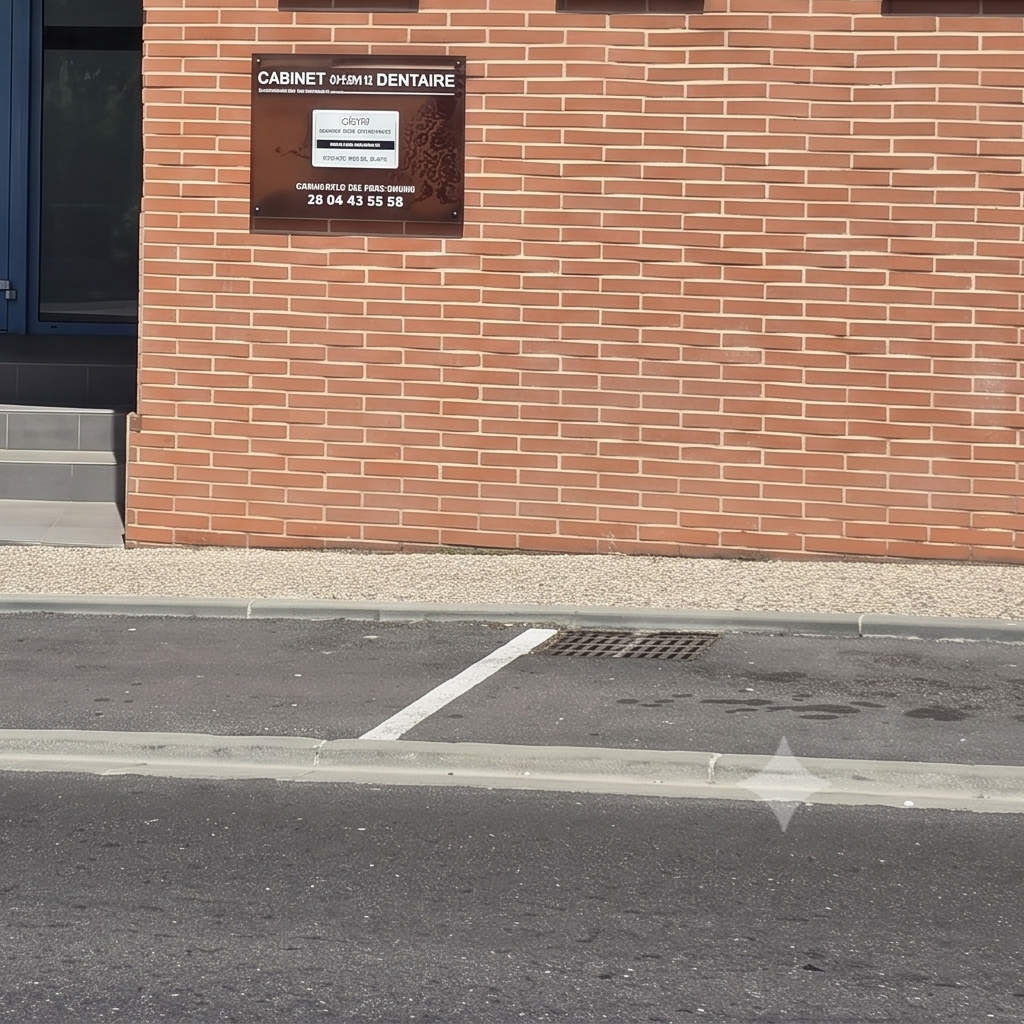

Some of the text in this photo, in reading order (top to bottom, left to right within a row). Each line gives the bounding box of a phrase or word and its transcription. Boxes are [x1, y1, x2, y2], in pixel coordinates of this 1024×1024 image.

[257, 71, 326, 86] CABINET
[376, 73, 456, 88] DENTAIRE
[307, 194, 404, 208] 28 04 43 55 58
